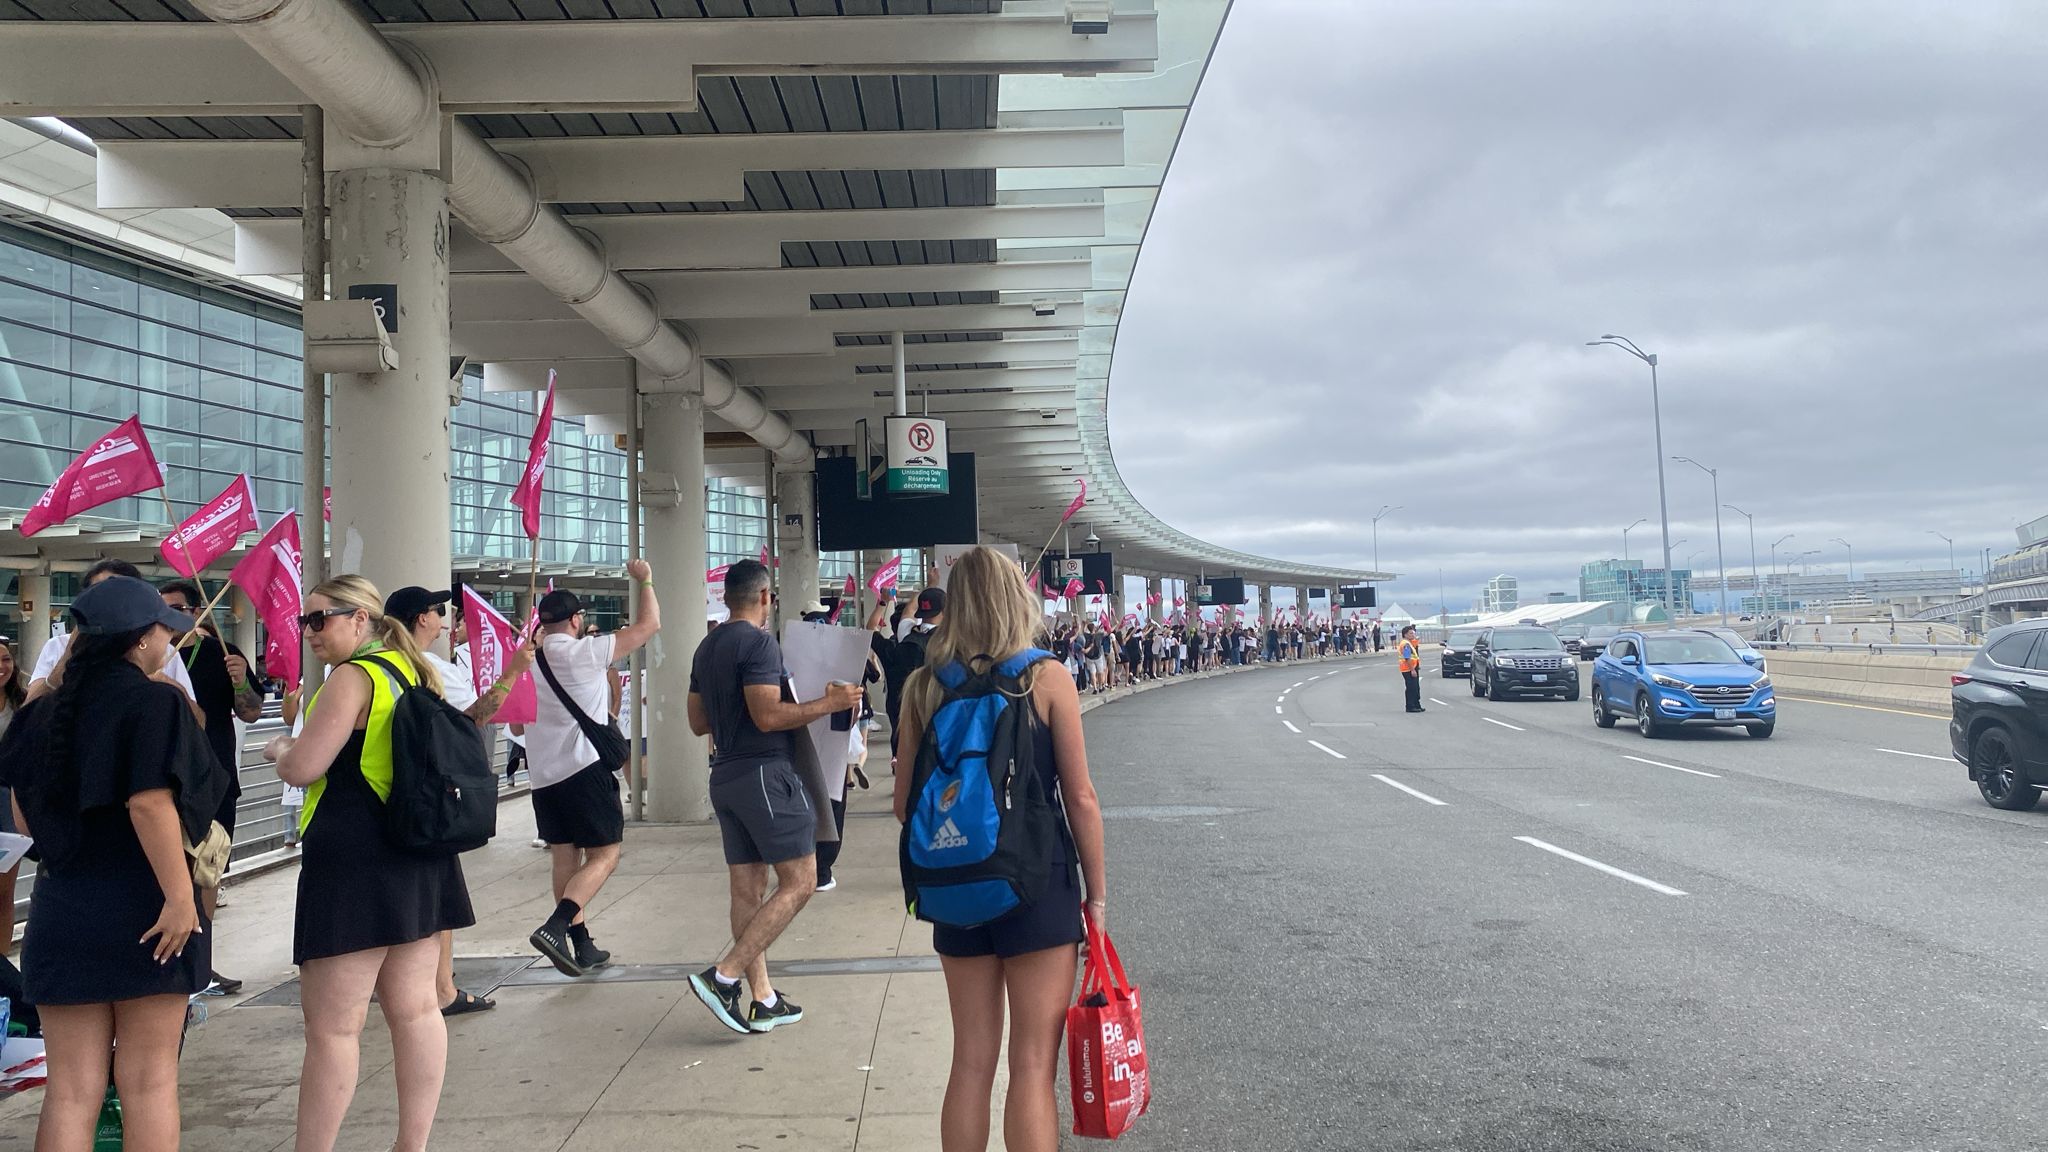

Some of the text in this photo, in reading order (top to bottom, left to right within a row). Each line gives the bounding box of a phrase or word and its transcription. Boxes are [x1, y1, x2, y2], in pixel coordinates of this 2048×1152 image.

[901, 469, 930, 477] Unloading
[927, 835, 969, 851] adidas
[1102, 1022, 1124, 1045] Be
[1082, 1039, 1093, 1088] lululemon
